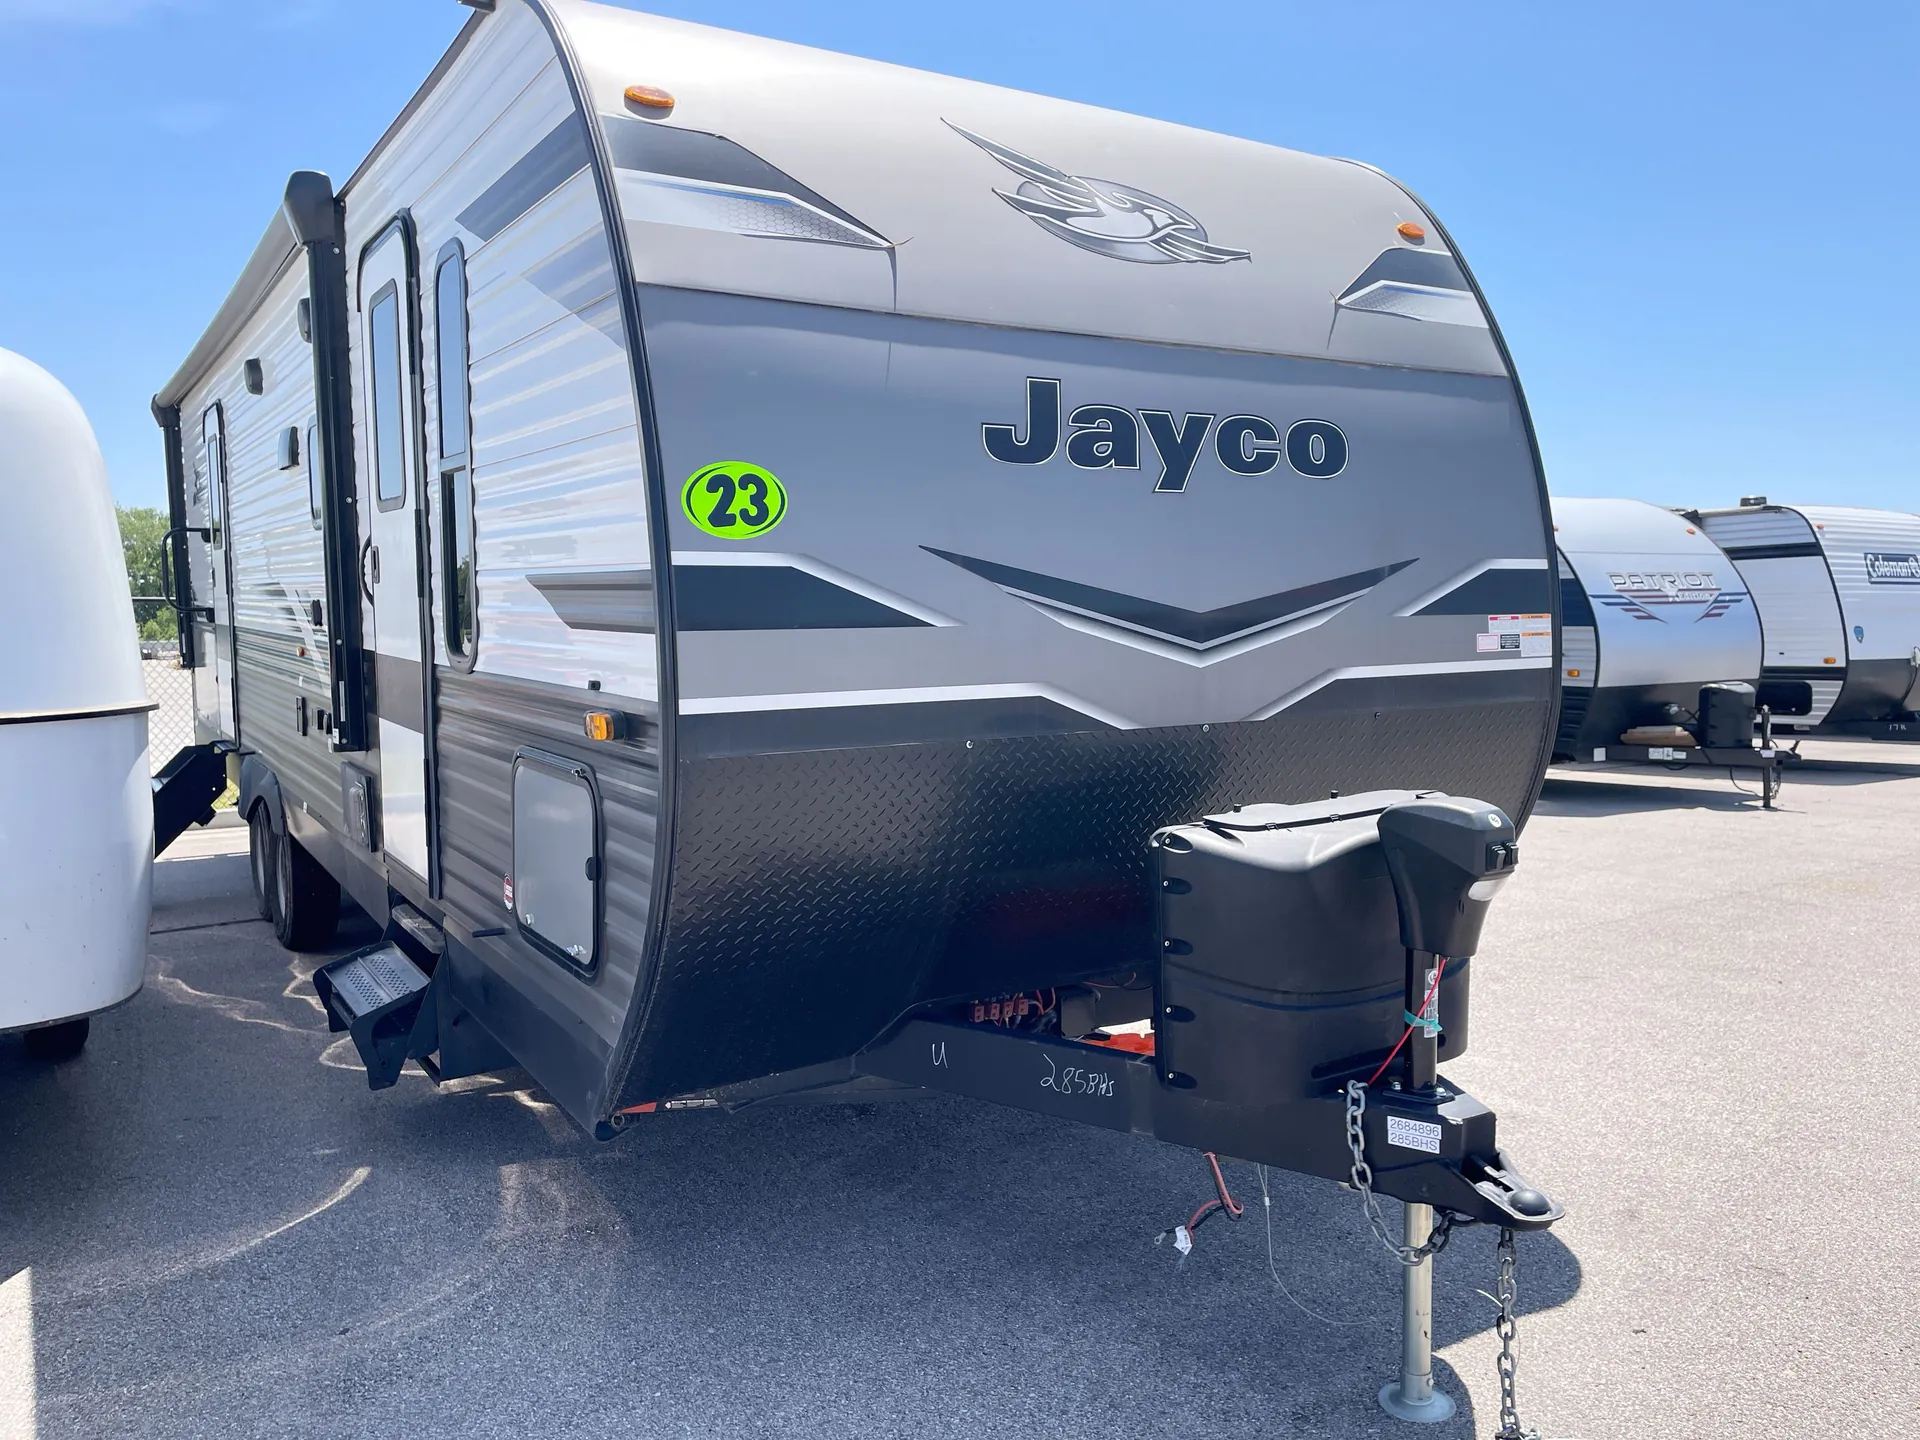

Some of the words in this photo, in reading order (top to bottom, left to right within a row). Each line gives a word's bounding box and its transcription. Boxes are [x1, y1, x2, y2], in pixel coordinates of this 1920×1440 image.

[981, 376, 1350, 493] Jayco
[706, 473, 769, 527] 23
[1867, 554, 1911, 577] Coleman
[1607, 572, 1716, 589] PATRIOT
[1389, 1118, 1440, 1137] 2684896
[1389, 1132, 1438, 1151] 285BHS
